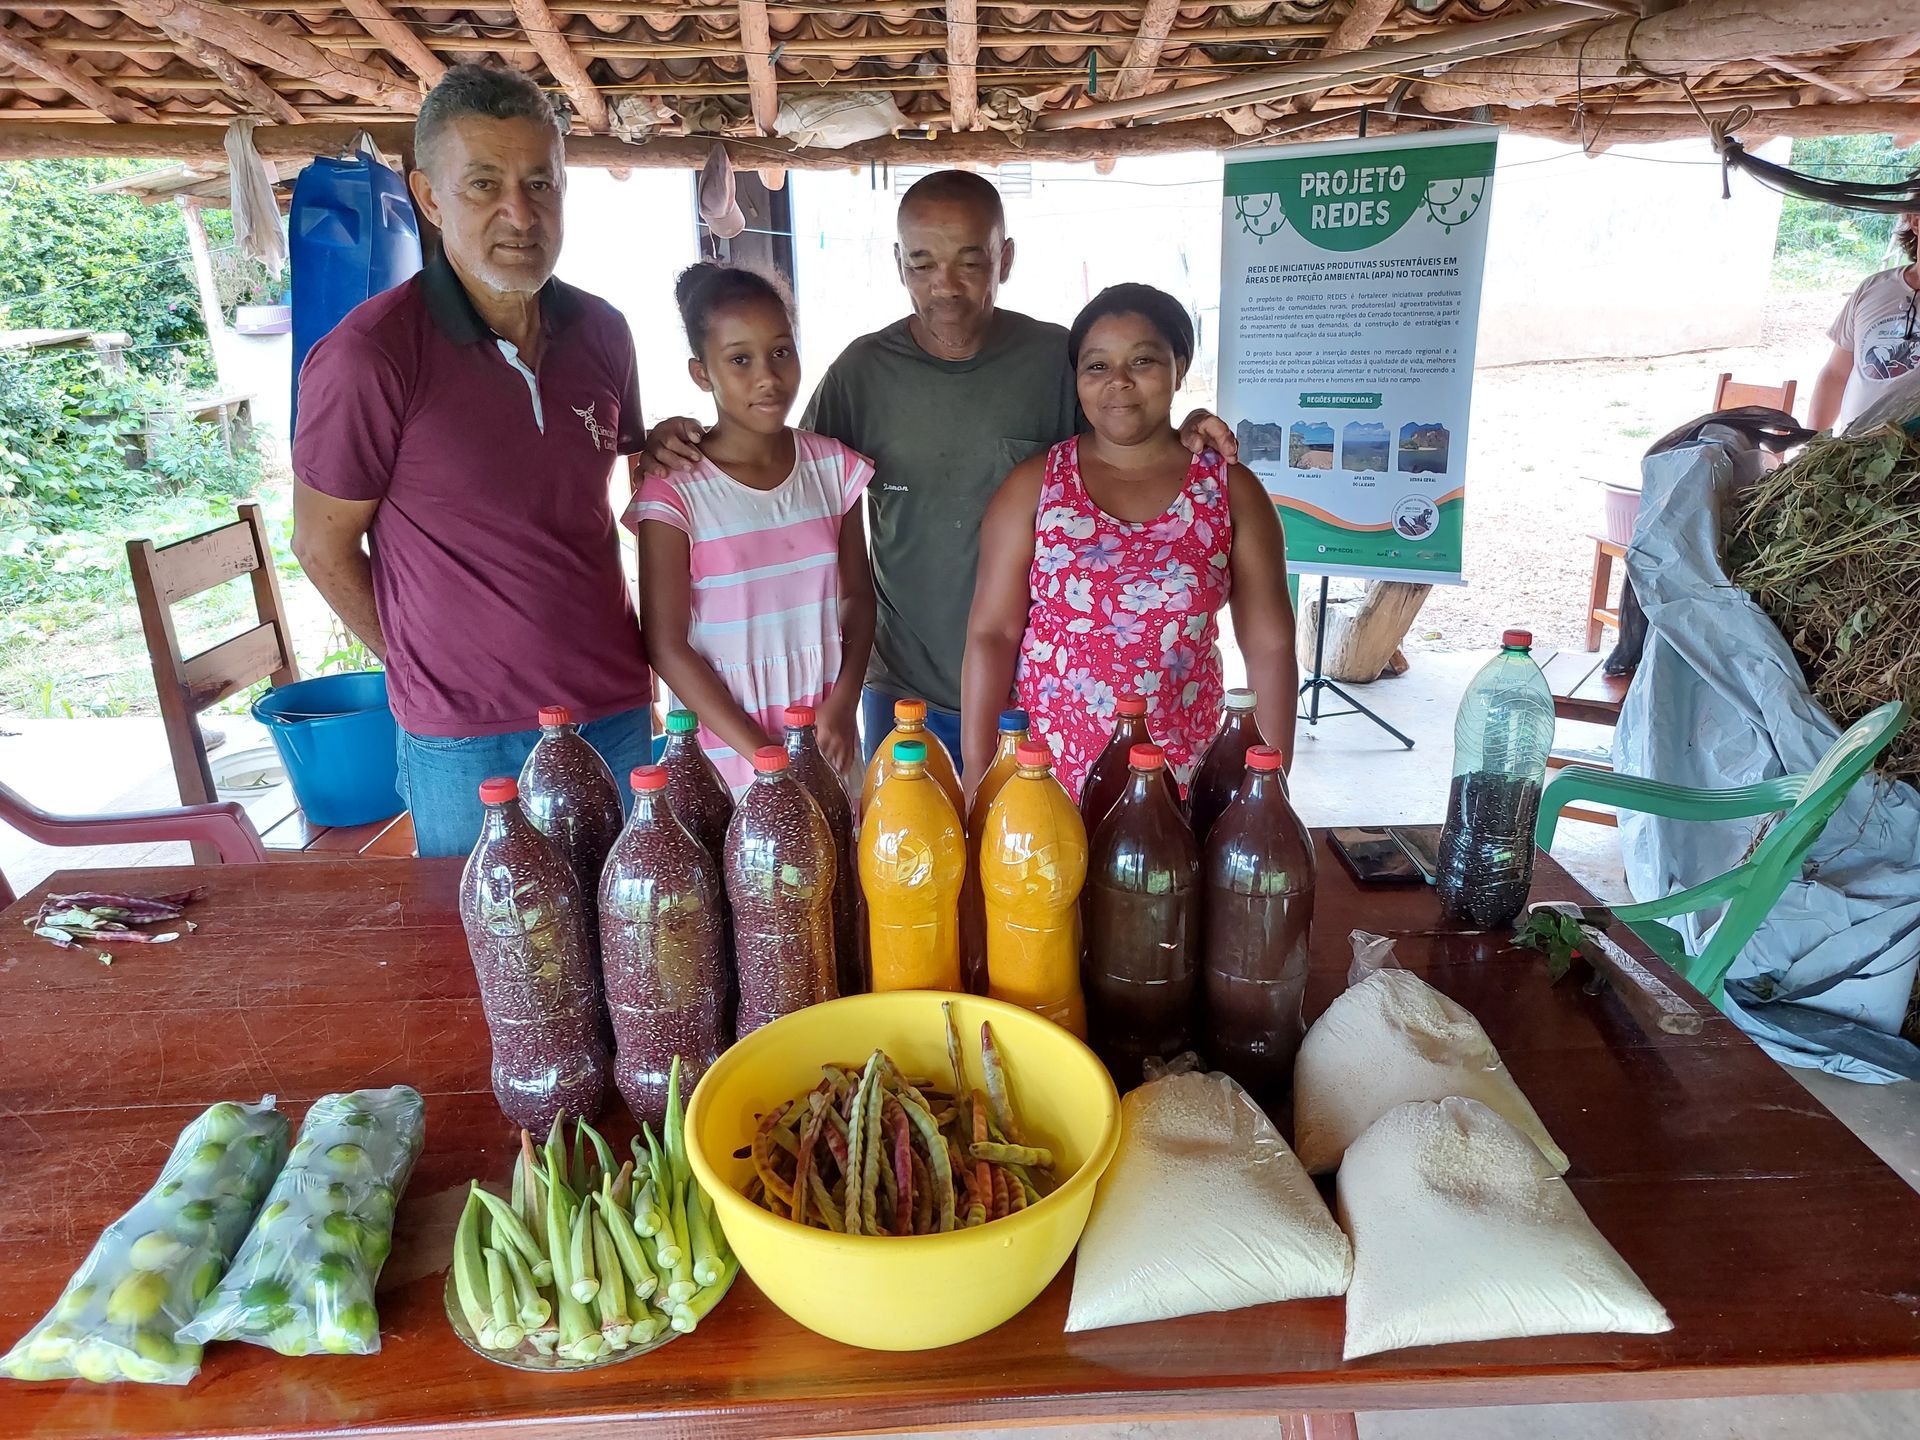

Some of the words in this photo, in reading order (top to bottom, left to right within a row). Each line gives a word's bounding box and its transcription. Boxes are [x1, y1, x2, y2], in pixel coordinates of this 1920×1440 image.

[1300, 165, 1406, 198] PROJETO
[1311, 200, 1390, 229] REDES
[1248, 265, 1266, 273] REDE
[1280, 263, 1325, 272] INICIATIVAS
[1327, 261, 1377, 270] PRODUTIVAS
[1379, 256, 1442, 268] SUSTENTÁVEIS
[1245, 274, 1269, 284] ÁREAS
[1282, 272, 1322, 284] PROTEÇÃO
[1324, 272, 1370, 281] AMBIENTAL
[1371, 271, 1394, 280] (APA)
[1410, 268, 1459, 278] TOCANTINS
[1256, 295, 1282, 304] propósito
[1427, 290, 1462, 299] produtivas
[1351, 301, 1396, 311] produtores(as)
[1399, 300, 1453, 309] agroextrativistas
[1315, 313, 1334, 321] quatro
[1336, 312, 1357, 320] regiões
[1393, 310, 1435, 318] tocantinense,
[1442, 309, 1460, 318] partir
[1251, 323, 1286, 331] mapeamento
[1318, 321, 1349, 329] demandas,
[1365, 320, 1399, 329] construção
[1415, 318, 1451, 328] estratégias
[1284, 331, 1317, 340] qualificação
[1253, 350, 1273, 358] projeto
[1322, 349, 1347, 357] inserção
[1416, 348, 1441, 356] regional
[1238, 358, 1278, 367] recomendação
[1288, 358, 1310, 366] políticas
[1312, 358, 1335, 366] públicas
[1369, 358, 1399, 366] qualidade
[1238, 368, 1264, 376] condições
[1238, 376, 1259, 385] geração
[1306, 394, 1331, 403] REGIÕES
